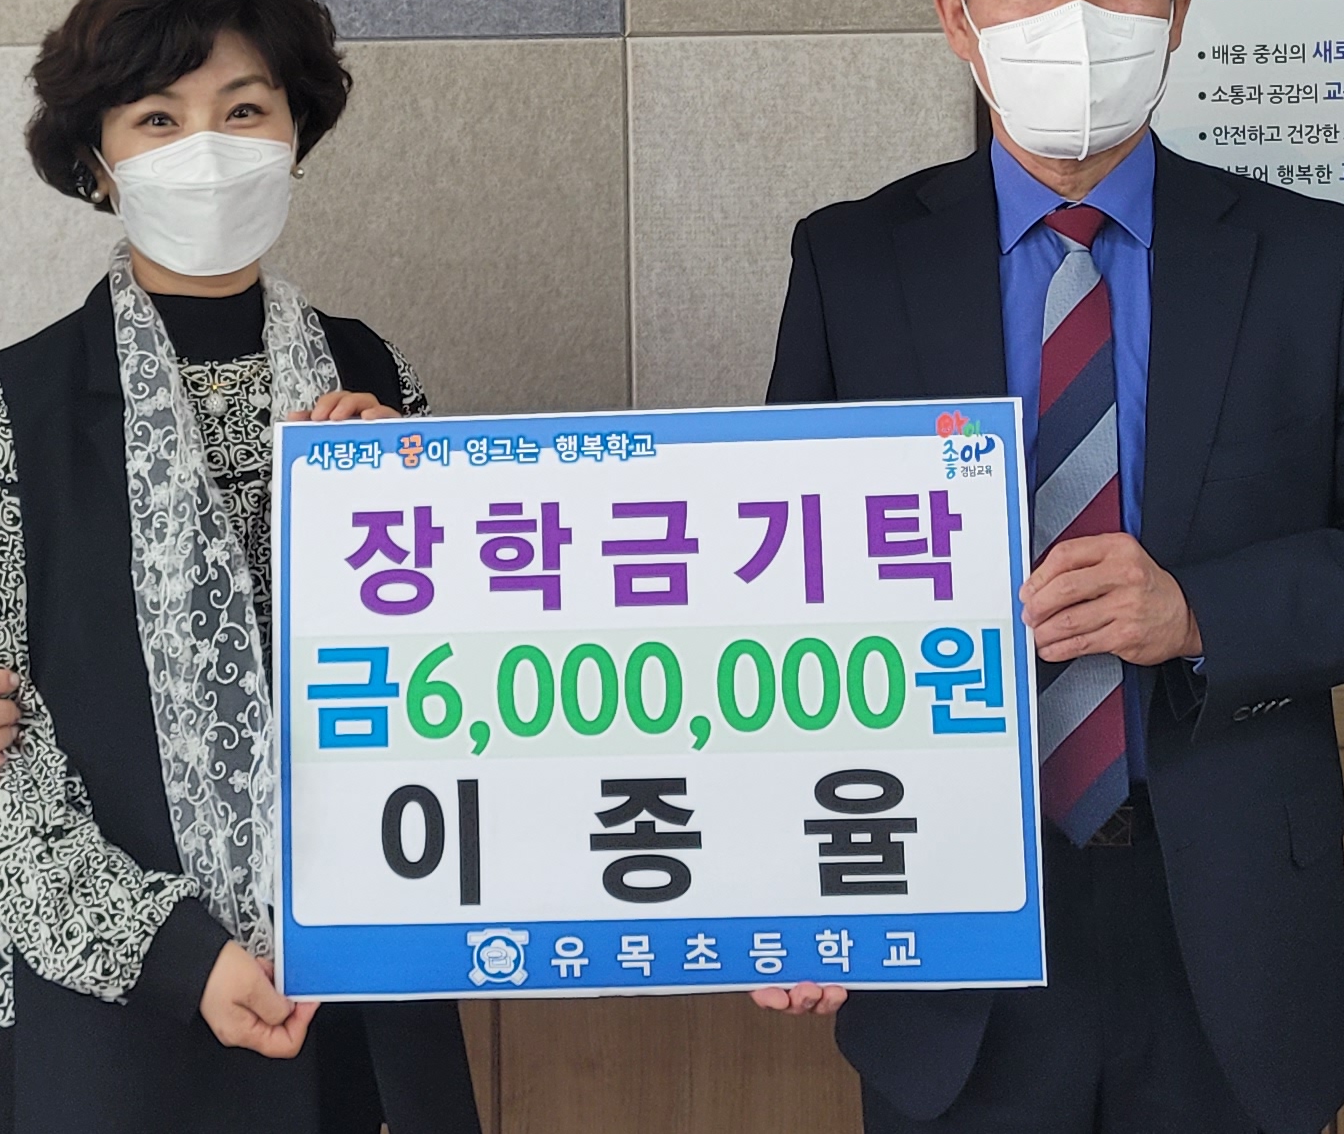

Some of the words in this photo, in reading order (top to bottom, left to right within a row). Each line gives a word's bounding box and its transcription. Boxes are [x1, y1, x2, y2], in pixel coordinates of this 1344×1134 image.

[1212, 44, 1247, 65] 배움
[1252, 43, 1306, 64] 중심의
[1211, 84, 1263, 105] 소통과
[1267, 83, 1318, 104] 공감의
[1213, 124, 1282, 146] 안전하고
[1287, 123, 1340, 145] 건강한
[1276, 164, 1333, 185] 행복한
[307, 440, 383, 470] 사랑과
[398, 434, 451, 468] 꿈이
[466, 436, 540, 466] 영그는
[554, 432, 657, 463] 행복학교
[960, 465, 993, 478] 경남교육
[306, 626, 1008, 757] 금6,000,000원
